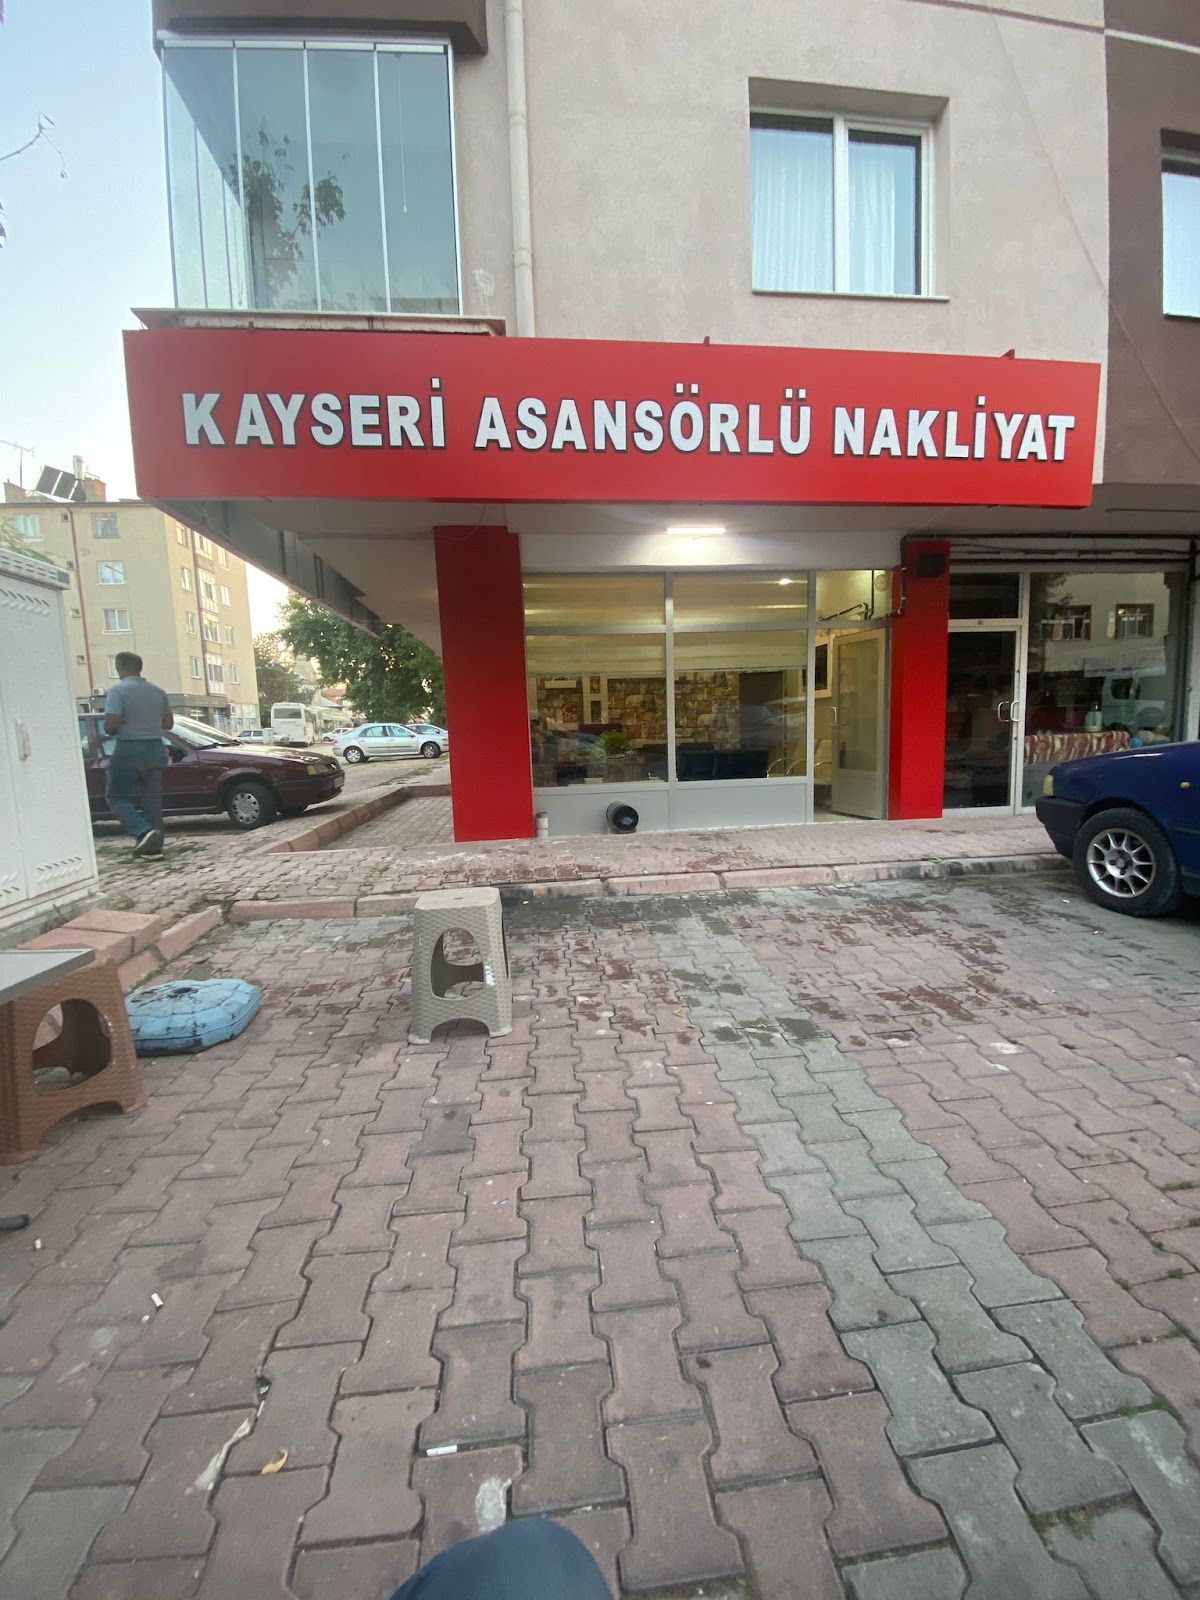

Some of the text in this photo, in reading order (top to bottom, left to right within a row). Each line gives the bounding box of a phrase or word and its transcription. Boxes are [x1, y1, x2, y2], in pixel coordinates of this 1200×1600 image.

[182, 377, 1076, 462] KAYSERİ ASANSÖRLÜ NAKLİYAT
